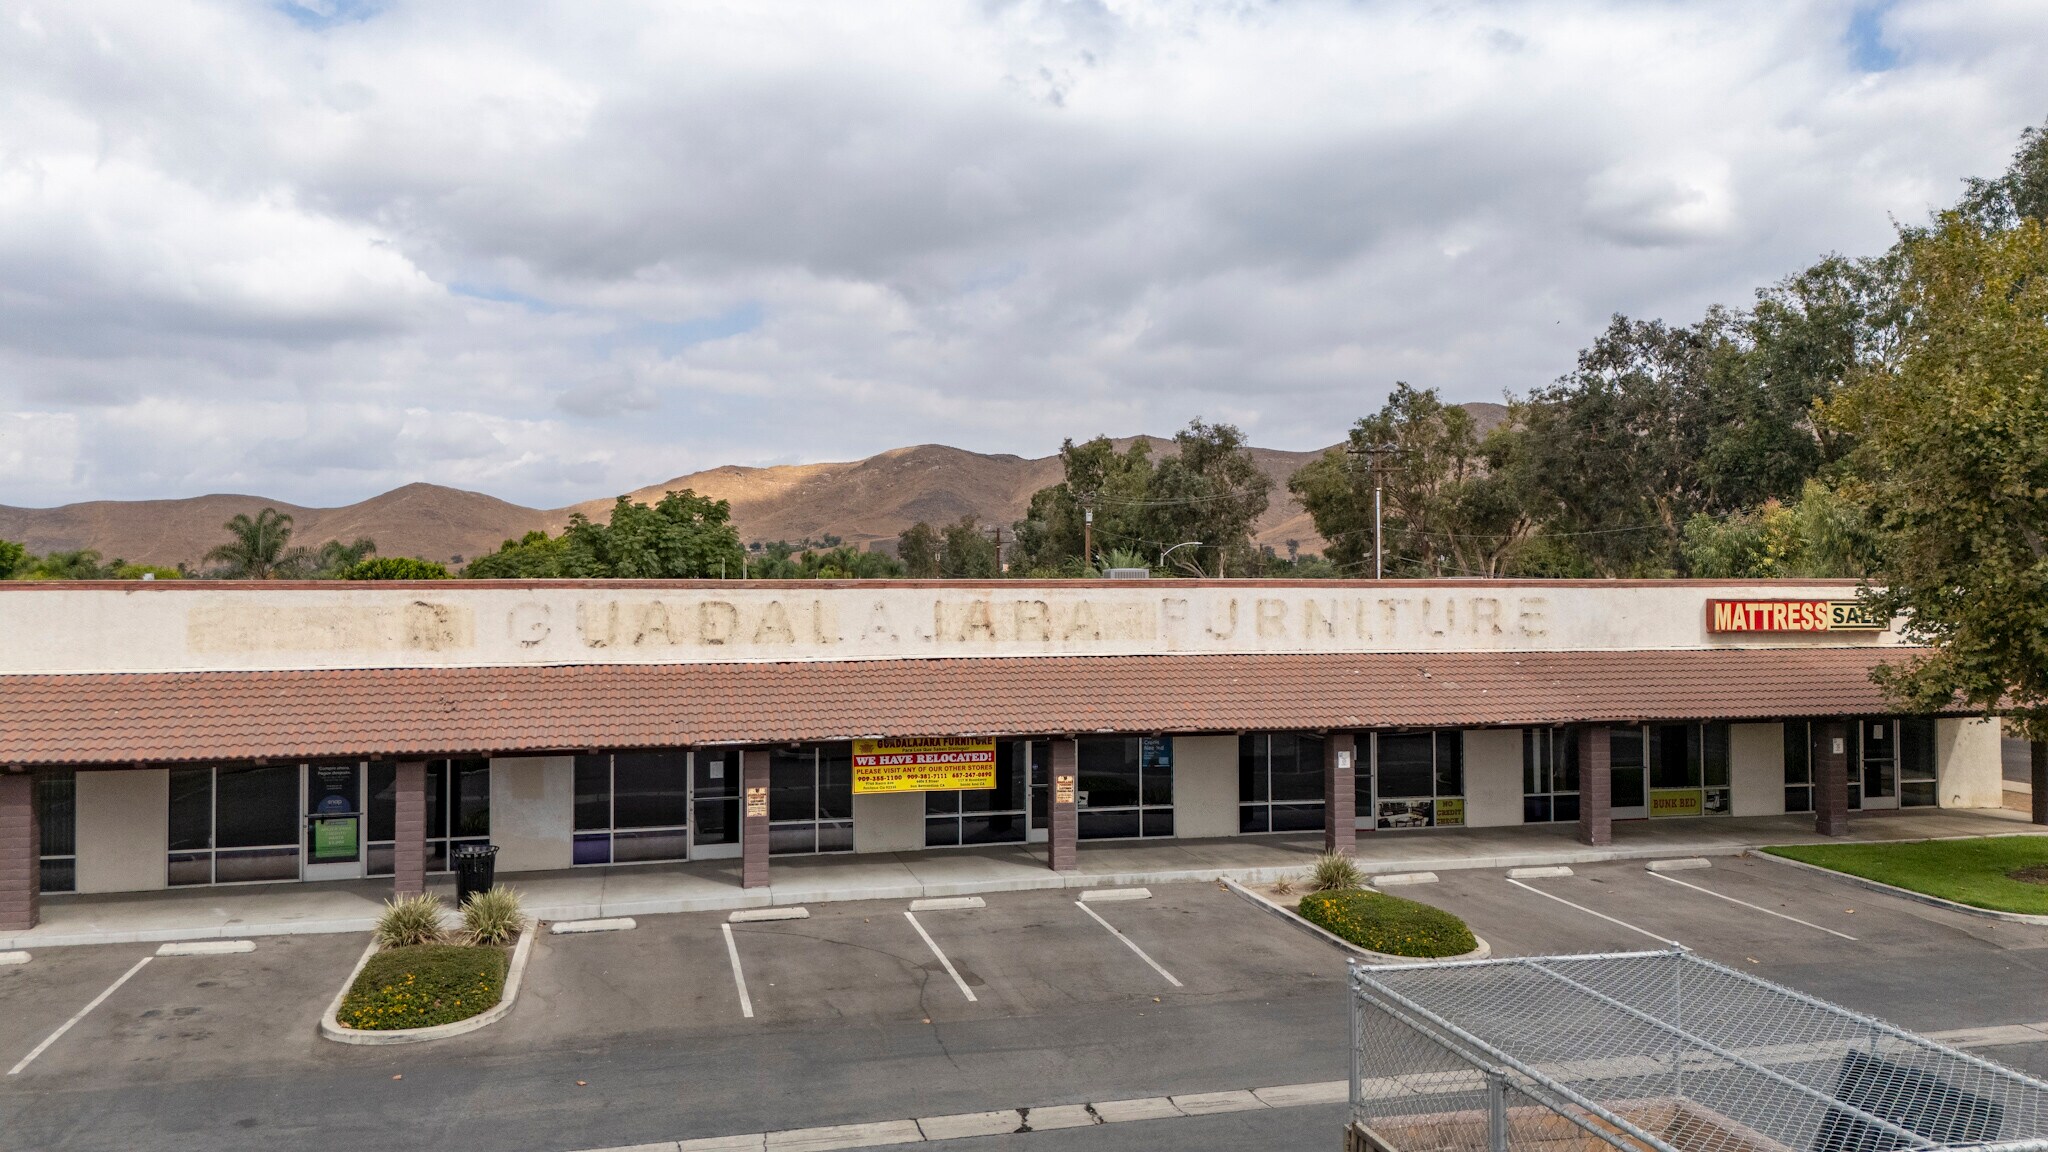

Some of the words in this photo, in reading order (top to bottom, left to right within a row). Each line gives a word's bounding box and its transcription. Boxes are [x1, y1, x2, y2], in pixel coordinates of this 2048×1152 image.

[1161, 596, 1549, 641] FURNITURE
[1714, 602, 1828, 631] MATTRESS
[1832, 607, 1883, 624] SAL
[856, 756, 876, 766] WE
[879, 755, 913, 765] HAVE
[916, 752, 992, 763] RELOCATED!
[1653, 799, 1677, 808] BUNK
[1679, 798, 1696, 808] BED
